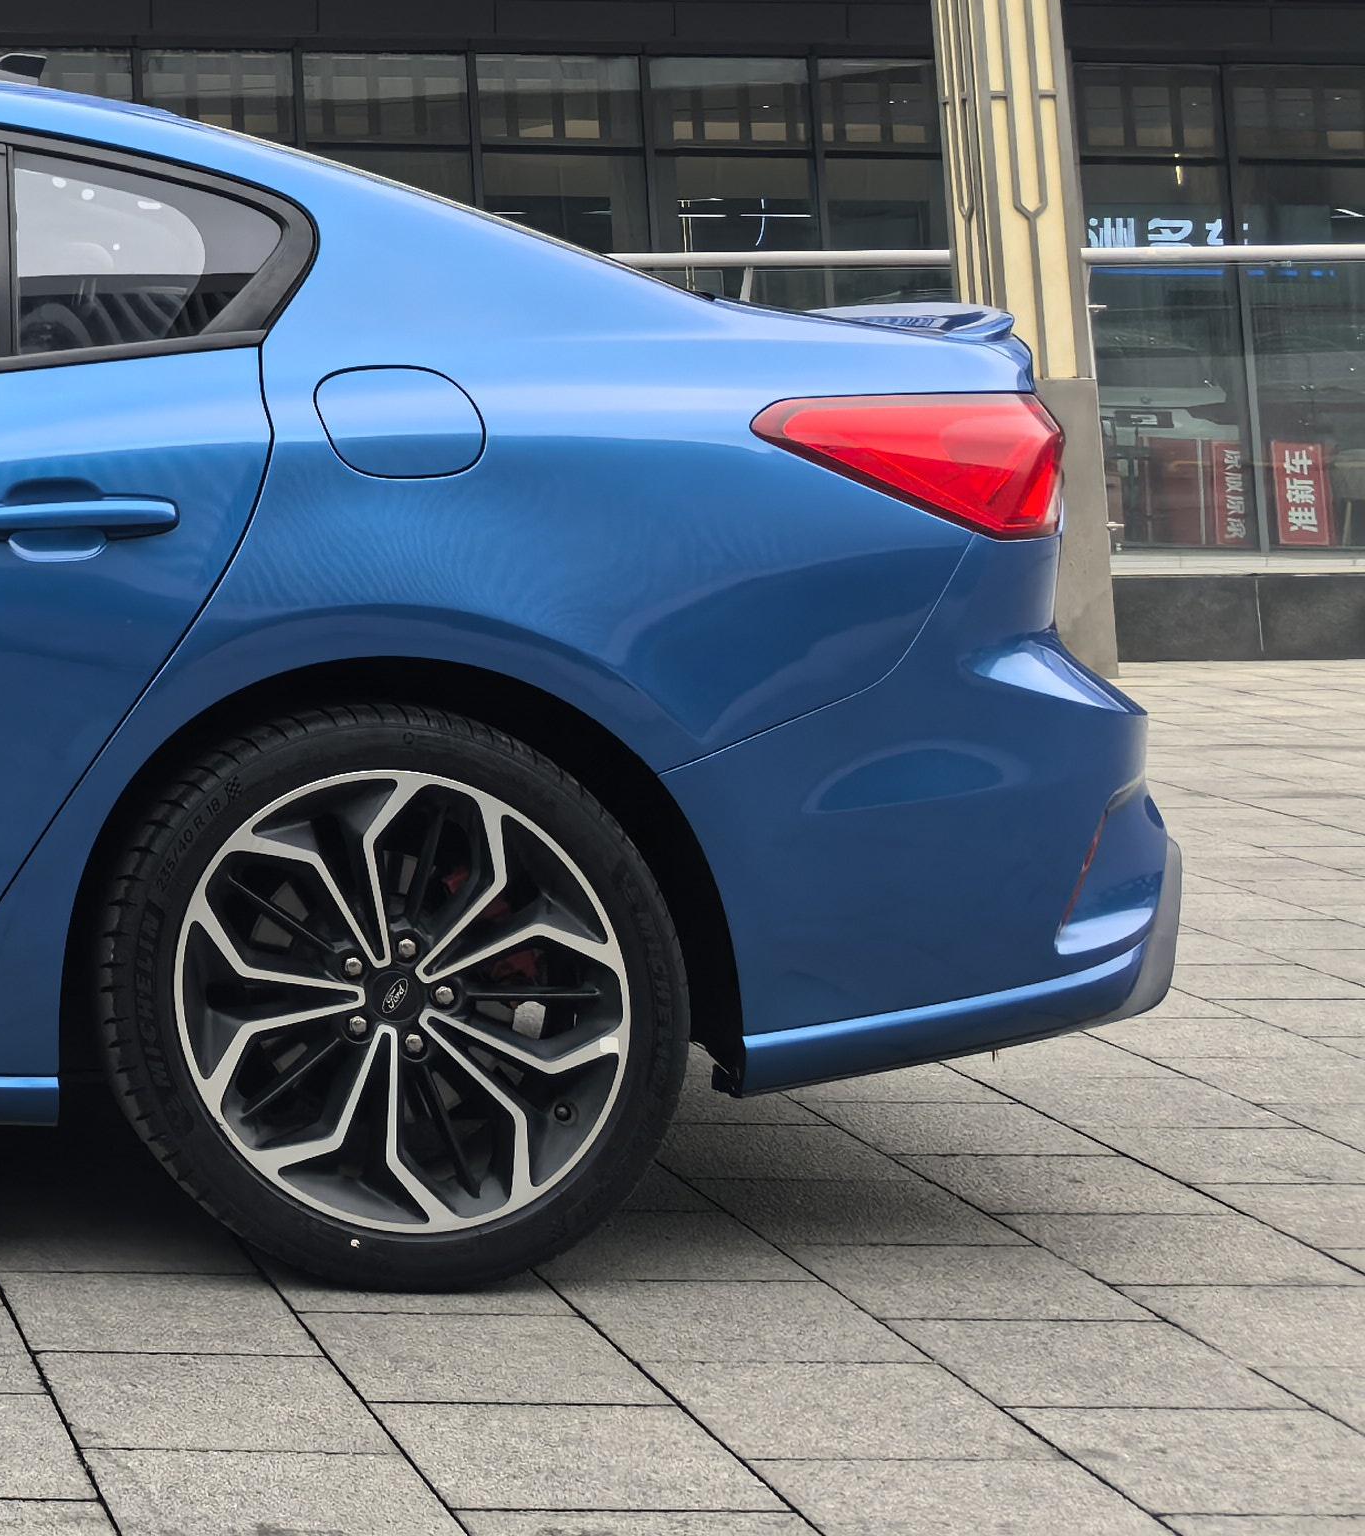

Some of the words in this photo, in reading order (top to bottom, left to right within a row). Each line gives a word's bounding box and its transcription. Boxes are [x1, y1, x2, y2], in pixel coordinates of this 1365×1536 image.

[1284, 448, 1317, 533] 准新车
[384, 982, 406, 1011] Ford
